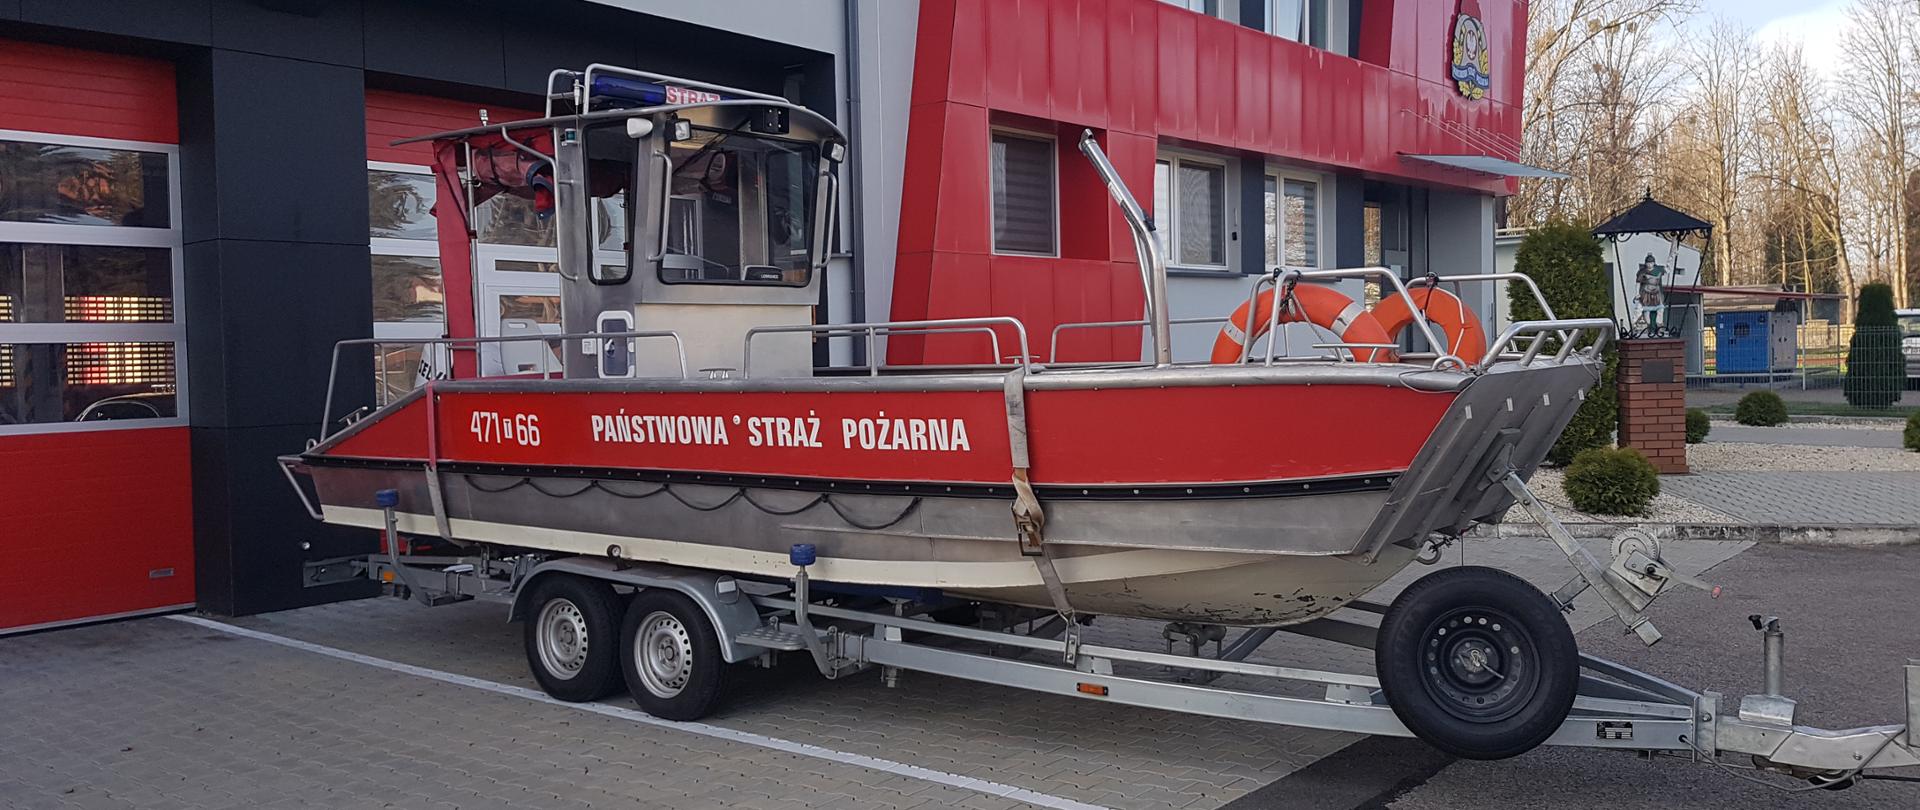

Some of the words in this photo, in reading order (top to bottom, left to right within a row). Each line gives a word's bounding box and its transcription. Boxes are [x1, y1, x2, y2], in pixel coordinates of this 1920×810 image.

[470, 411, 501, 444] 471
[515, 413, 541, 446] 66
[591, 408, 729, 445] PAŃSTWOWA
[747, 410, 823, 448] STRAŻ
[842, 411, 971, 451] POŻARNA
